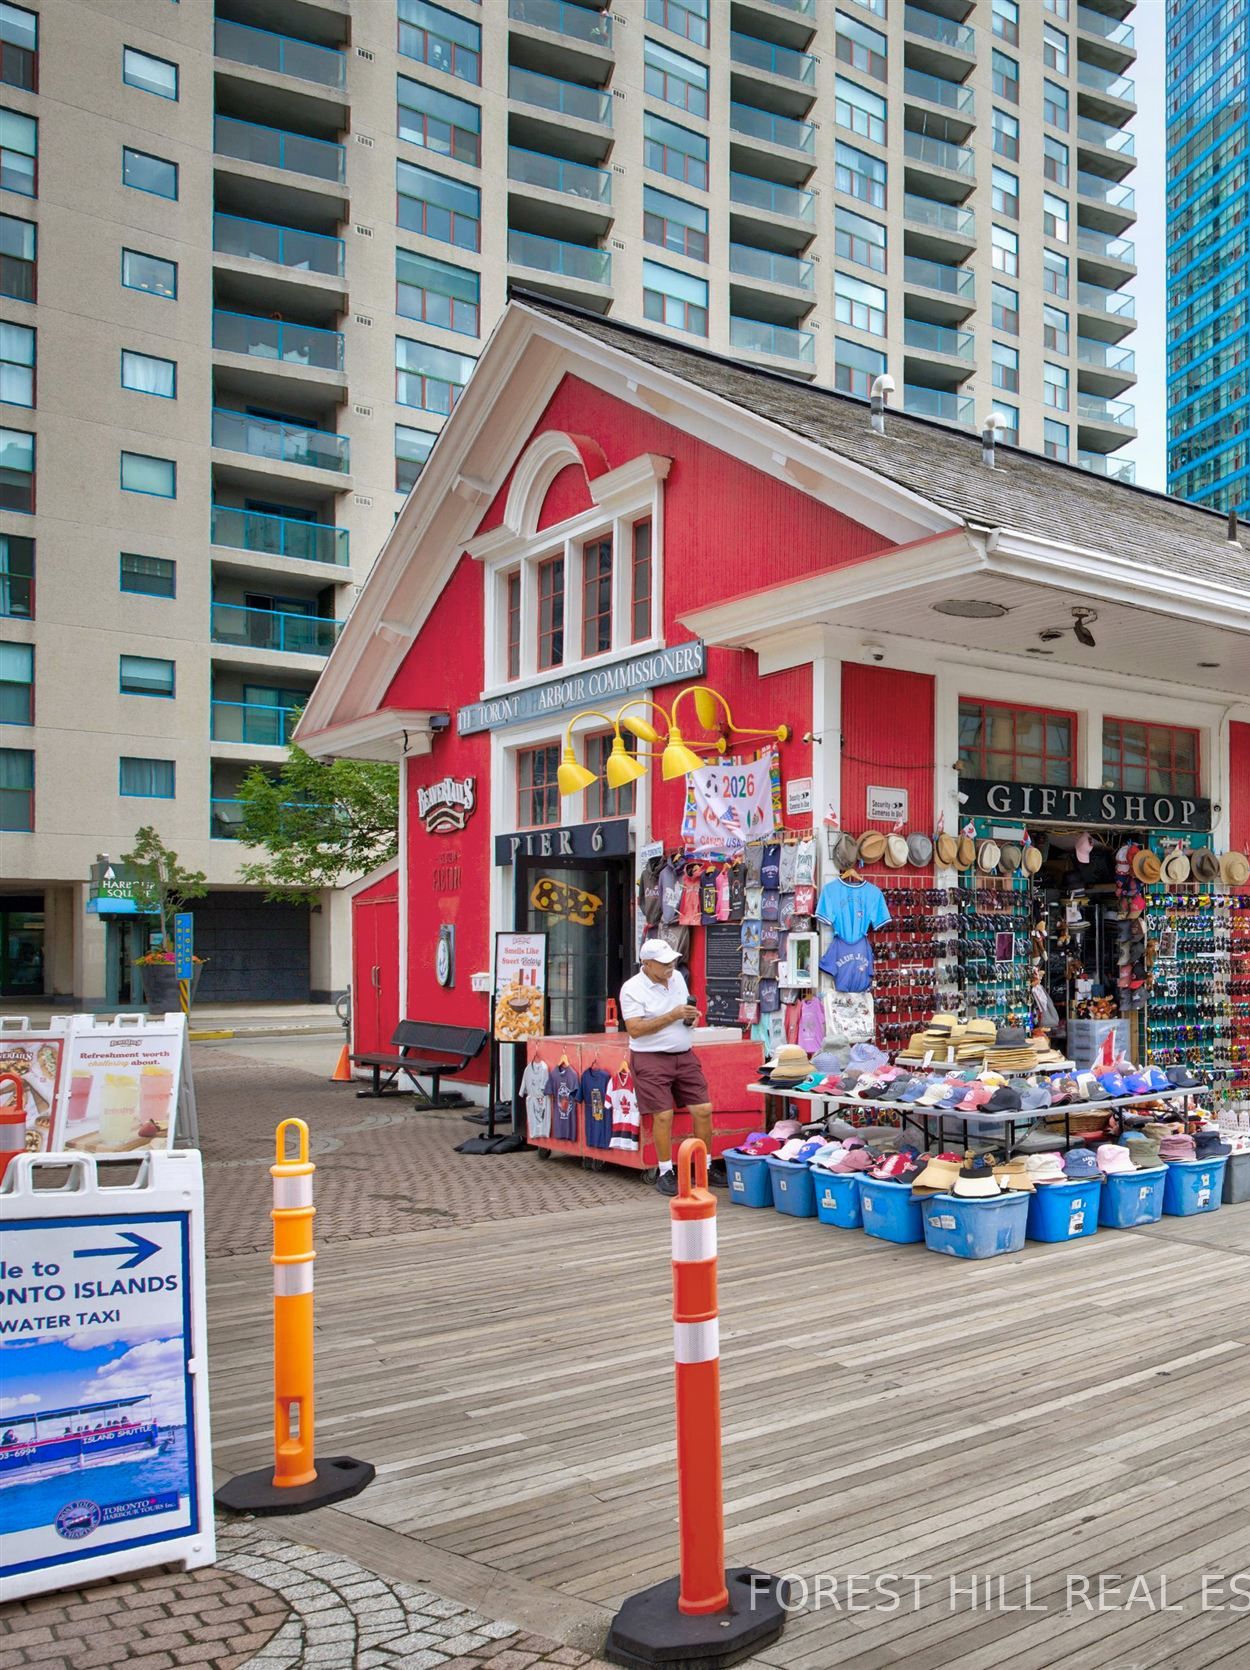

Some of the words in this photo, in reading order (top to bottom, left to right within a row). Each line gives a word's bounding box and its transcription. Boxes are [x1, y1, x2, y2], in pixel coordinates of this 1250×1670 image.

[589, 645, 703, 696] COMMISSIONERS
[722, 773, 755, 798] 2026
[872, 800, 891, 809] Security
[872, 808, 890, 817] Cameras
[987, 785, 1082, 817] GIFT
[1101, 794, 1196, 825] SHOP
[510, 829, 573, 860] PIER
[591, 826, 603, 851] 6
[726, 837, 742, 848] USA
[836, 953, 855, 967] BLUE
[32, 1261, 60, 1277] to
[74, 1274, 178, 1299] ISLANDS
[0, 1314, 71, 1334] WATER
[76, 1309, 120, 1325] TAXI
[82, 1433, 115, 1445] ISLAND
[117, 1425, 152, 1438] SHUTTLE
[102, 1500, 149, 1515] TORONTO
[102, 1509, 139, 1522] HARBOUR
[141, 1504, 164, 1514] TOURS
